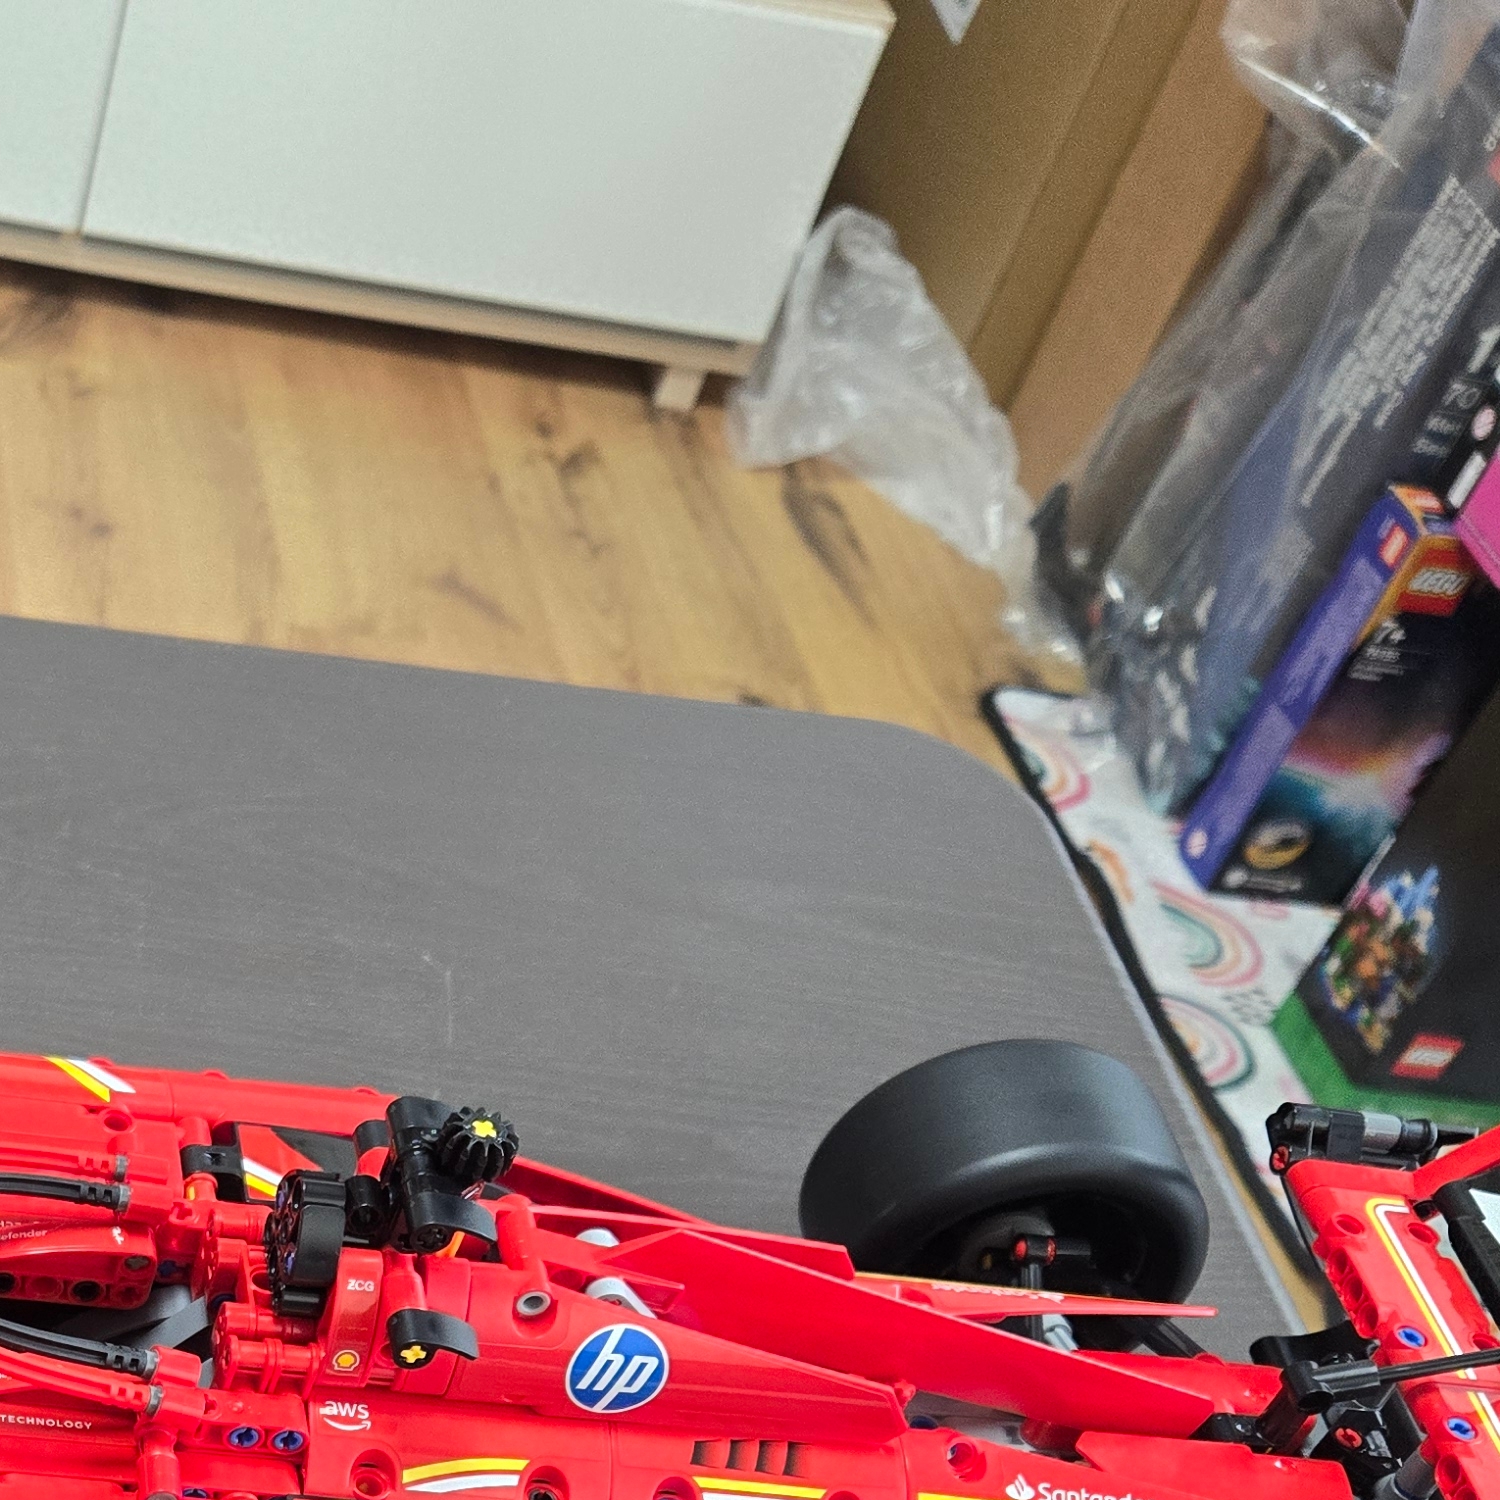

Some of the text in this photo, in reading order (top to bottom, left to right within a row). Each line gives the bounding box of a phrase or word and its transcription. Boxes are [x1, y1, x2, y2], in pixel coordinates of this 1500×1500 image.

[347, 1279, 375, 1292] ZCG
[574, 1324, 660, 1412] hp
[0, 1413, 92, 1430] TECHNOLOGY
